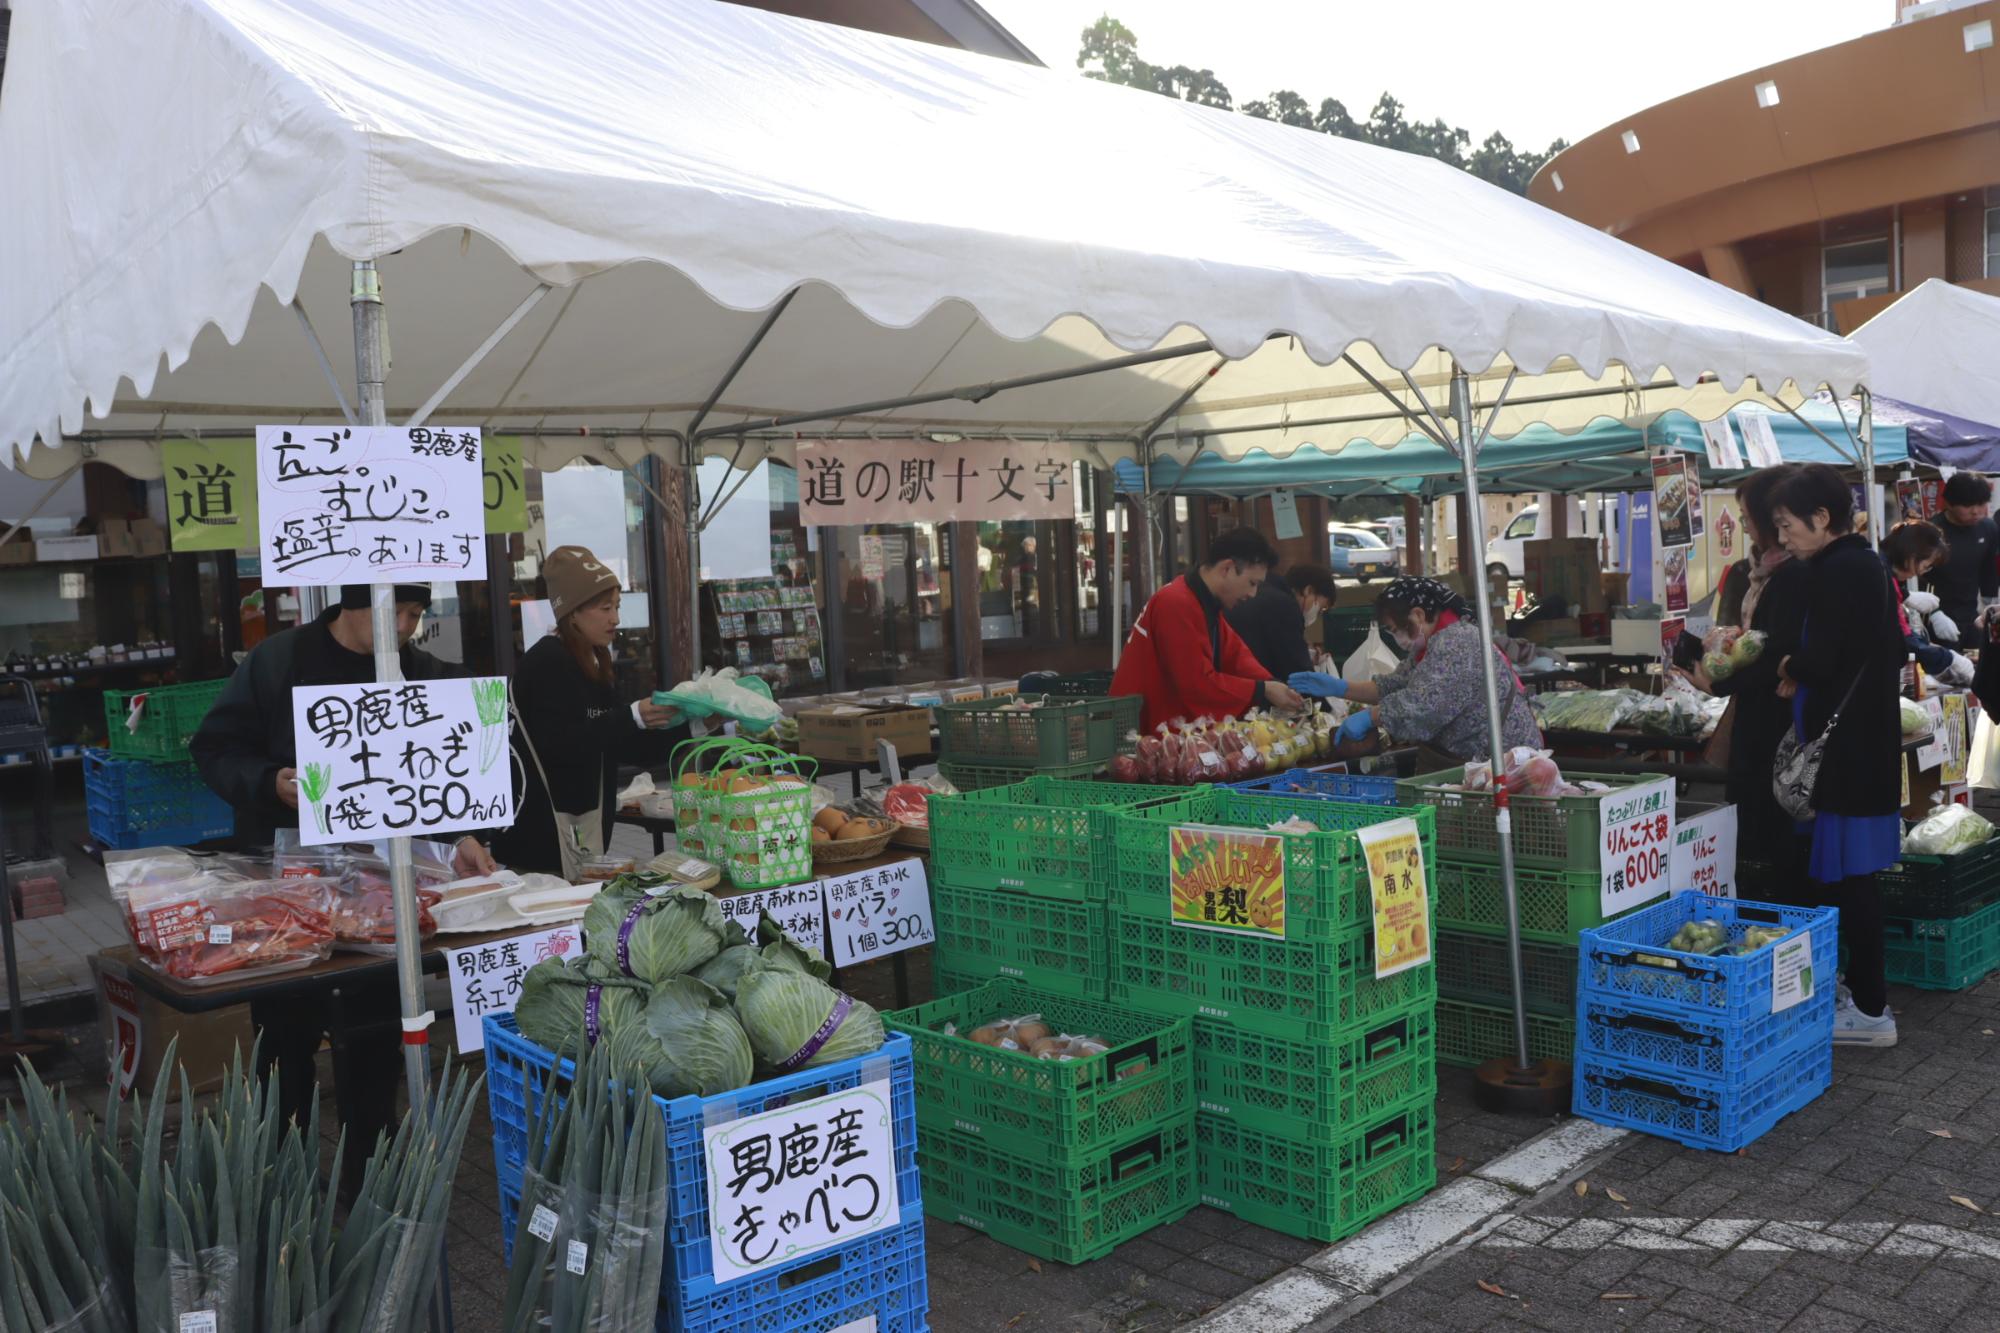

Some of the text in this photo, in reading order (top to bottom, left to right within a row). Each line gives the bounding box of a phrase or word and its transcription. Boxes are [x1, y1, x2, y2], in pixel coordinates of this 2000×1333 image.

[408, 428, 479, 461] 男鹿産
[173, 463, 238, 527] 道
[803, 457, 1069, 507] 道の駅十文字
[307, 684, 444, 749] 男鹿産
[337, 721, 474, 791] 土ねぎ
[1607, 813, 1668, 857] りんご大袋
[1383, 869, 1413, 897] 南水
[1606, 847, 1668, 895] 1袋600円
[846, 891, 886, 922] バラ
[1218, 886, 1249, 925] 梨
[457, 942, 521, 977] 男鹿産
[726, 1107, 869, 1198] 男鹿産
[732, 1173, 880, 1264] きゃべつ
